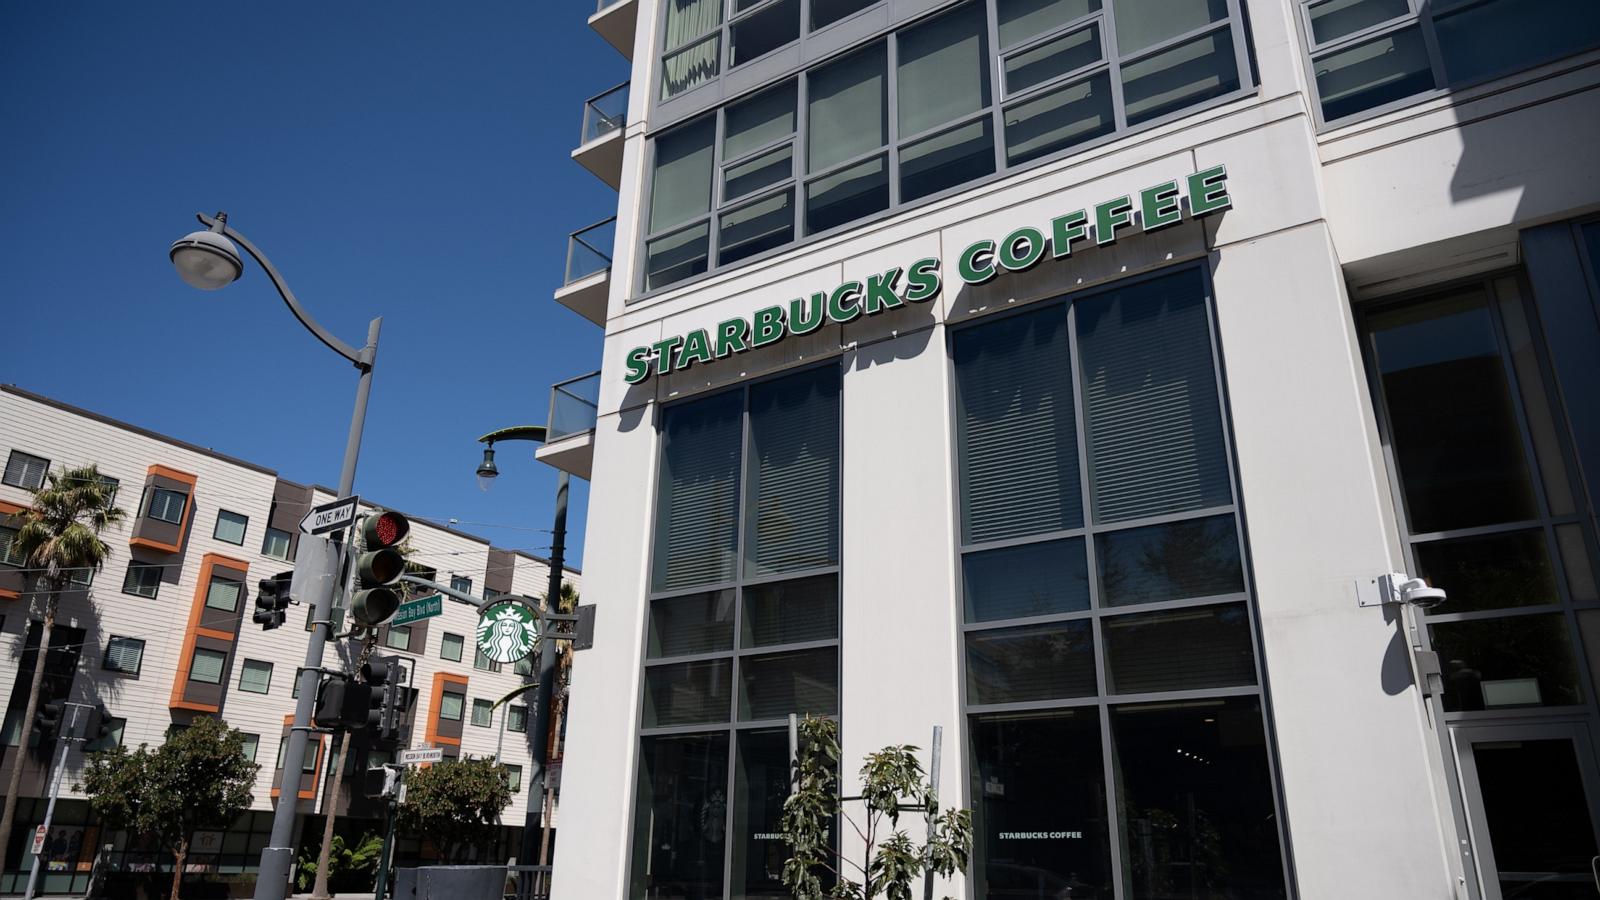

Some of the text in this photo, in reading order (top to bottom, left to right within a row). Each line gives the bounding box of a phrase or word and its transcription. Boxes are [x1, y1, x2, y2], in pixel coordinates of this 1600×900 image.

[624, 164, 1232, 384] STARBUCKS COFFEE
[316, 505, 351, 526] ONE WAY
[998, 831, 1083, 840] STARBUCKS COFFEE
